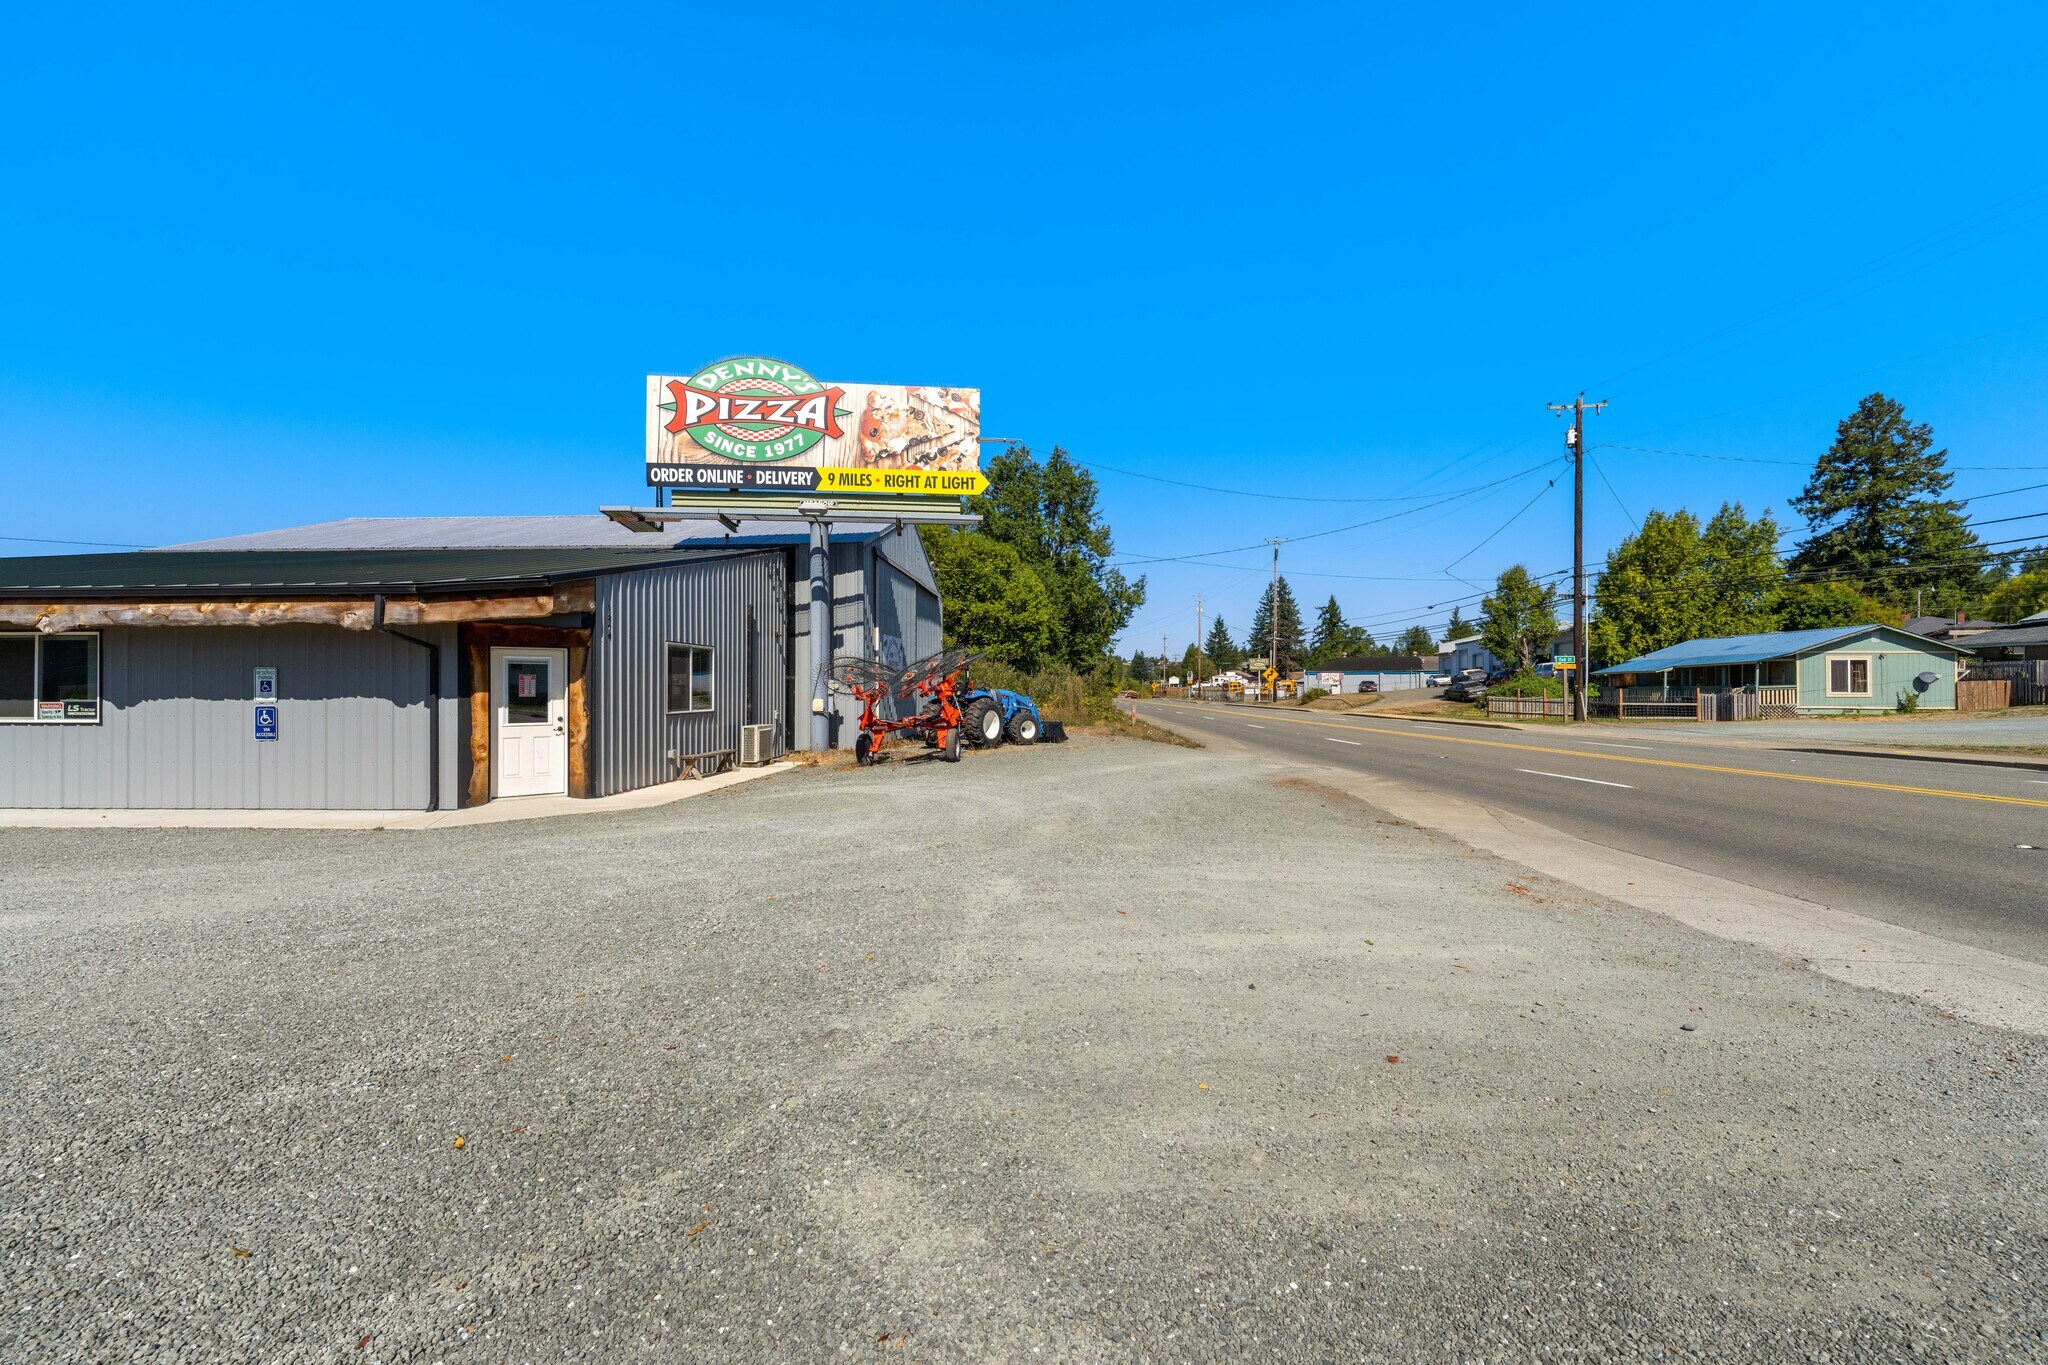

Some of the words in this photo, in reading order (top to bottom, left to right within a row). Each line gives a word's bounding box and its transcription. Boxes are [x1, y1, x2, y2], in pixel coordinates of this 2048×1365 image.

[695, 361, 819, 393] DENNY'S
[684, 389, 828, 430] PIZZA
[704, 431, 757, 459] SINCE
[764, 433, 805, 458] 1977
[650, 467, 693, 483] ORDER
[696, 468, 744, 484] ONLINE
[755, 470, 814, 486] DELIVERY
[828, 472, 836, 486] 9
[838, 473, 872, 487] MILES
[884, 474, 921, 489] RIGHT
[923, 475, 938, 489] AT
[941, 476, 976, 490] LIGHT
[67, 704, 80, 712] LS
